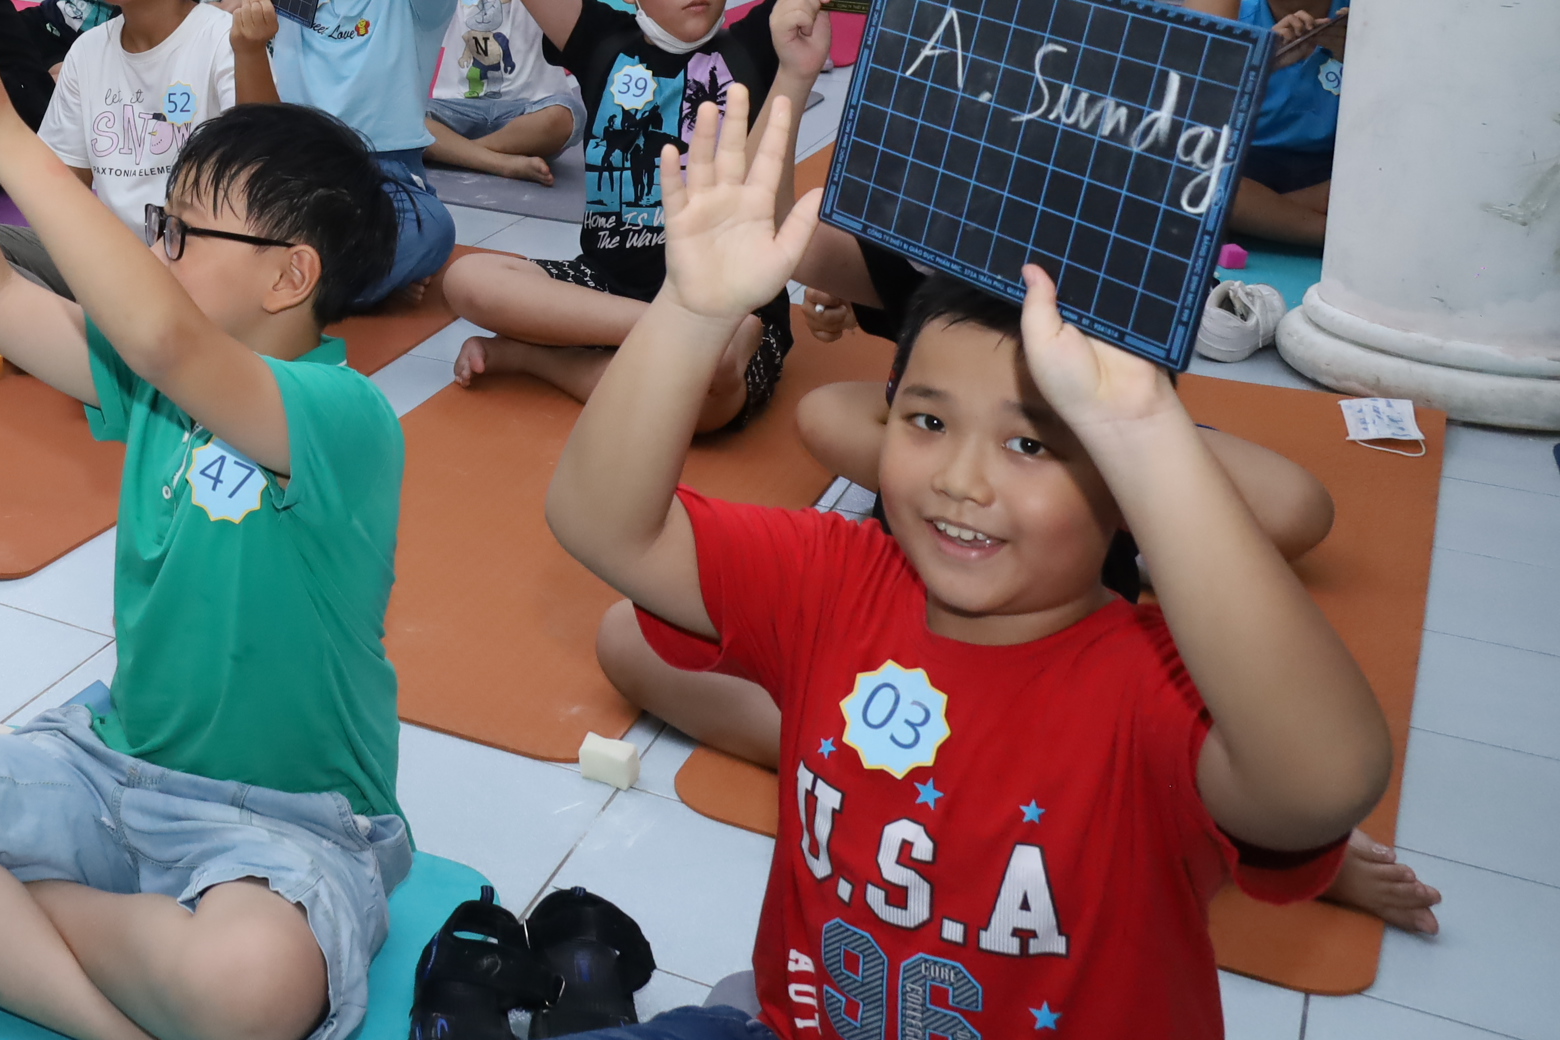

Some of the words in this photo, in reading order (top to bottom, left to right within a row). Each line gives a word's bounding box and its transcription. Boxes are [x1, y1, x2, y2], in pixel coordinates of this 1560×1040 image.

[328, 25, 356, 40] Love
[472, 36, 490, 57] N
[130, 88, 144, 104] it
[617, 73, 648, 98] 39
[167, 91, 191, 113] 52
[1011, 43, 1236, 214] Sunday
[584, 210, 616, 230] Home
[620, 211, 648, 230] IS
[597, 230, 620, 249] The
[866, 227, 883, 239] CÔNG
[199, 454, 257, 499] 47
[862, 681, 931, 750] 03
[796, 759, 1070, 958] U.S.A
